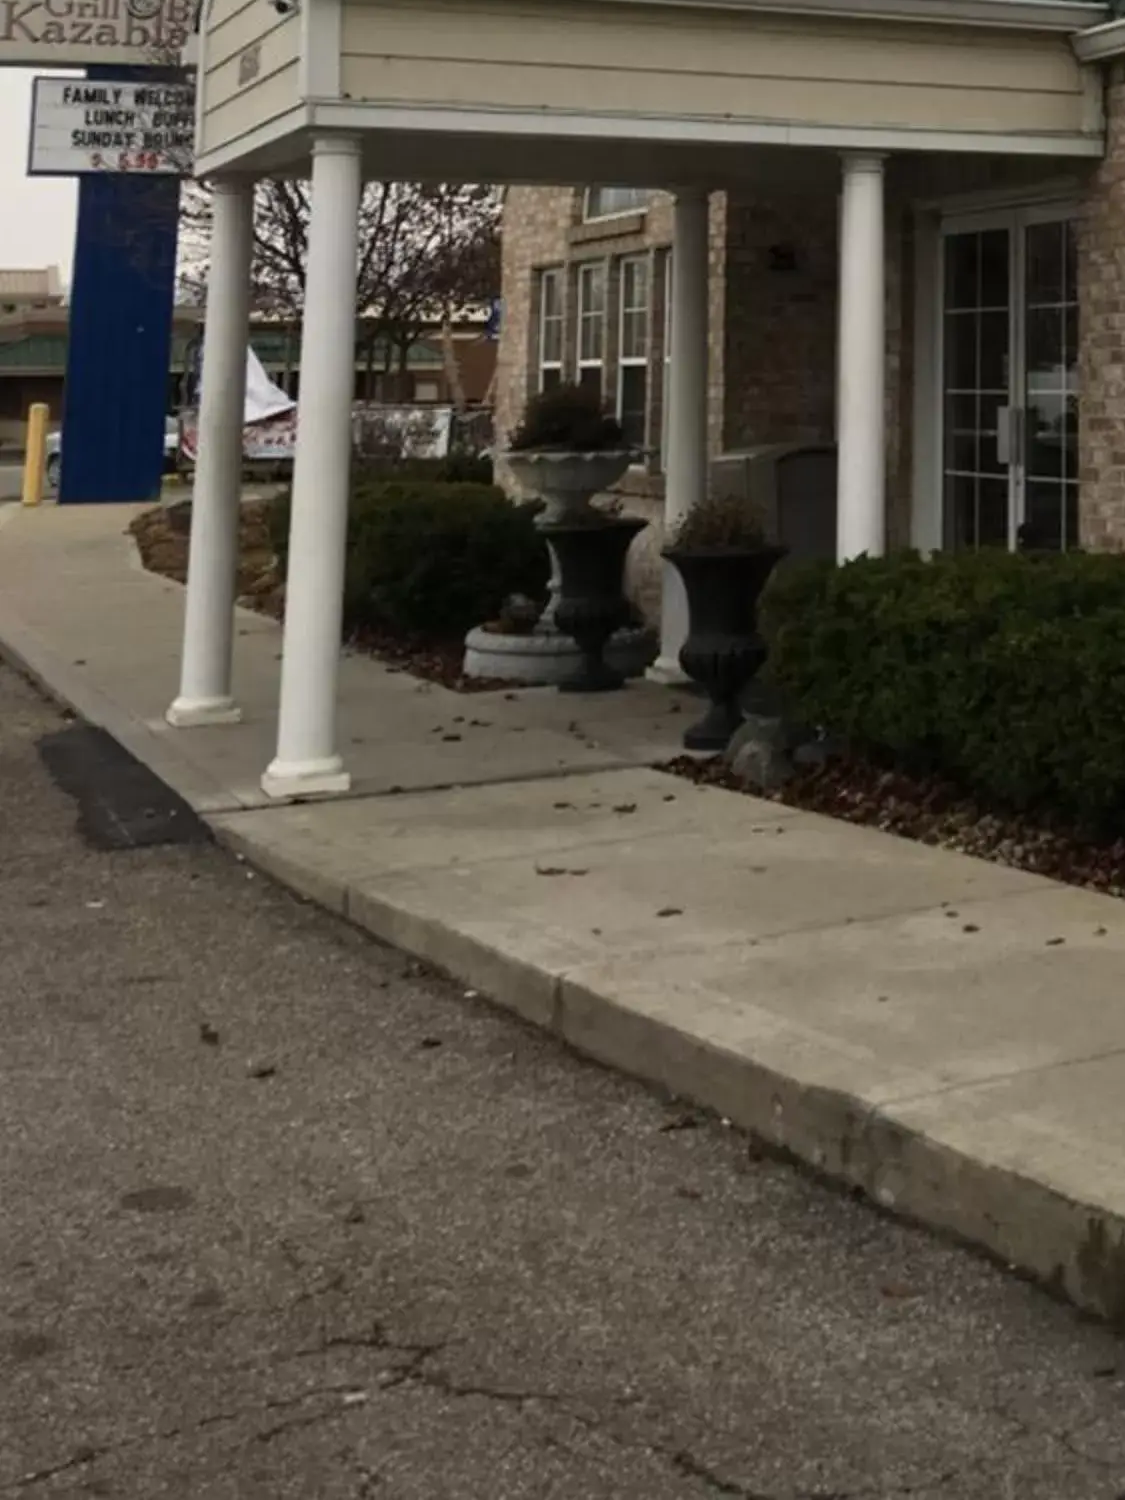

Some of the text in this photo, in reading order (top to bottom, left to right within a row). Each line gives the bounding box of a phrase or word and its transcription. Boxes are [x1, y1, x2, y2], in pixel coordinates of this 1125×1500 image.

[62, 87, 122, 104] FAMILY
[84, 110, 135, 127] LUNCH
[71, 129, 136, 148] SUNDAY
